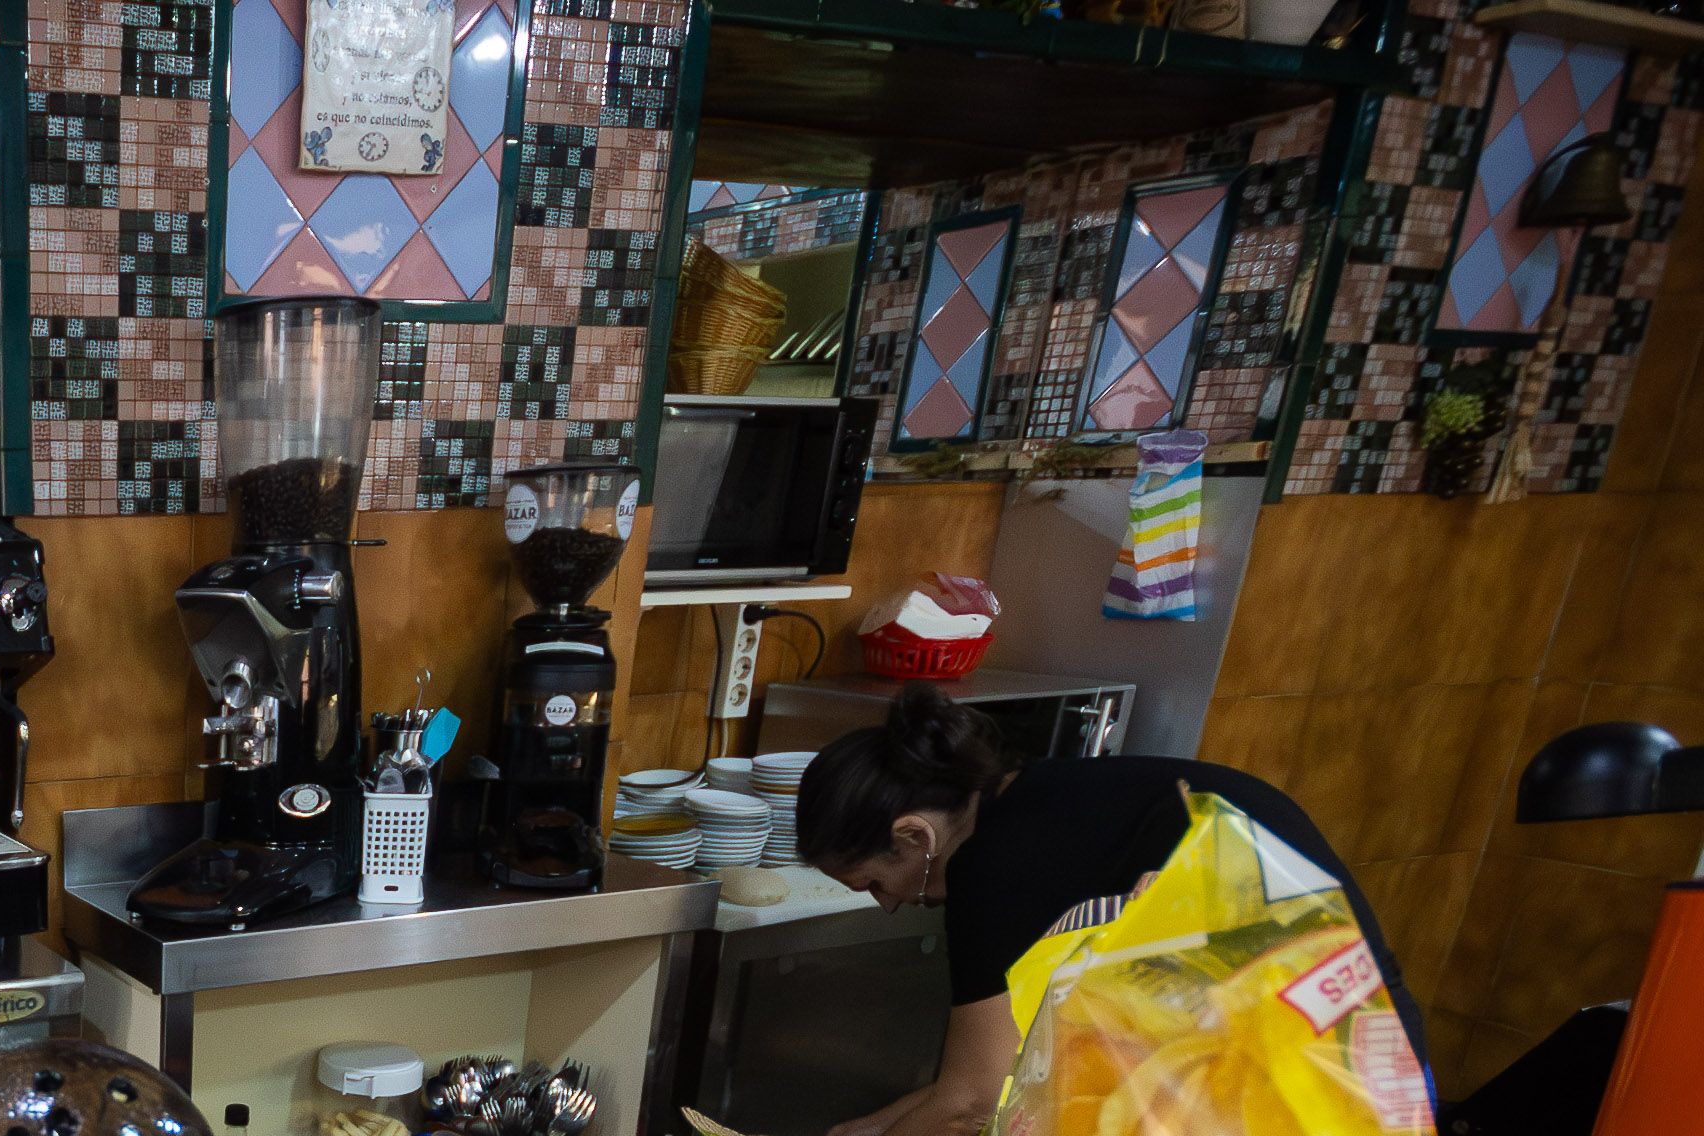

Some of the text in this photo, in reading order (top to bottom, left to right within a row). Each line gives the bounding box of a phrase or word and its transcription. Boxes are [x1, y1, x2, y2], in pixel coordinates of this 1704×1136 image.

[316, 111, 434, 130] es que no coincidimos.
[506, 505, 538, 521] AZAR
